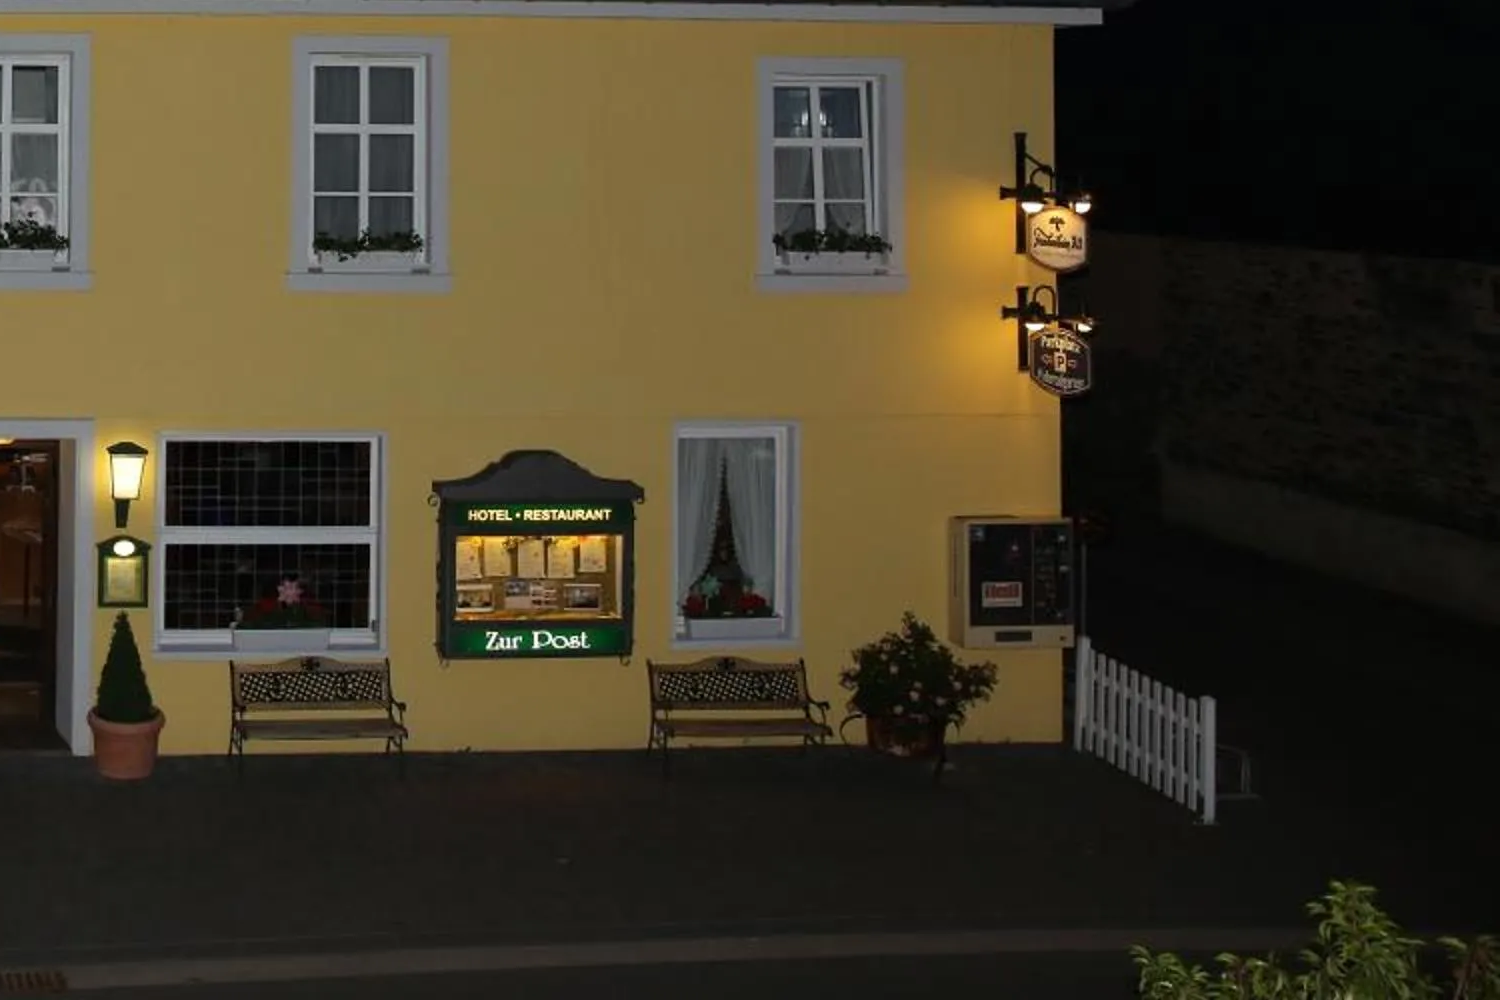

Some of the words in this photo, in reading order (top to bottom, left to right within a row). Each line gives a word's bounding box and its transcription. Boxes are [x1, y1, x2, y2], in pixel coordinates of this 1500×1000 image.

[467, 509, 513, 521] HOTEL
[523, 509, 612, 521] RESTAURANT
[485, 630, 522, 651] Zur
[531, 629, 591, 649] Post
